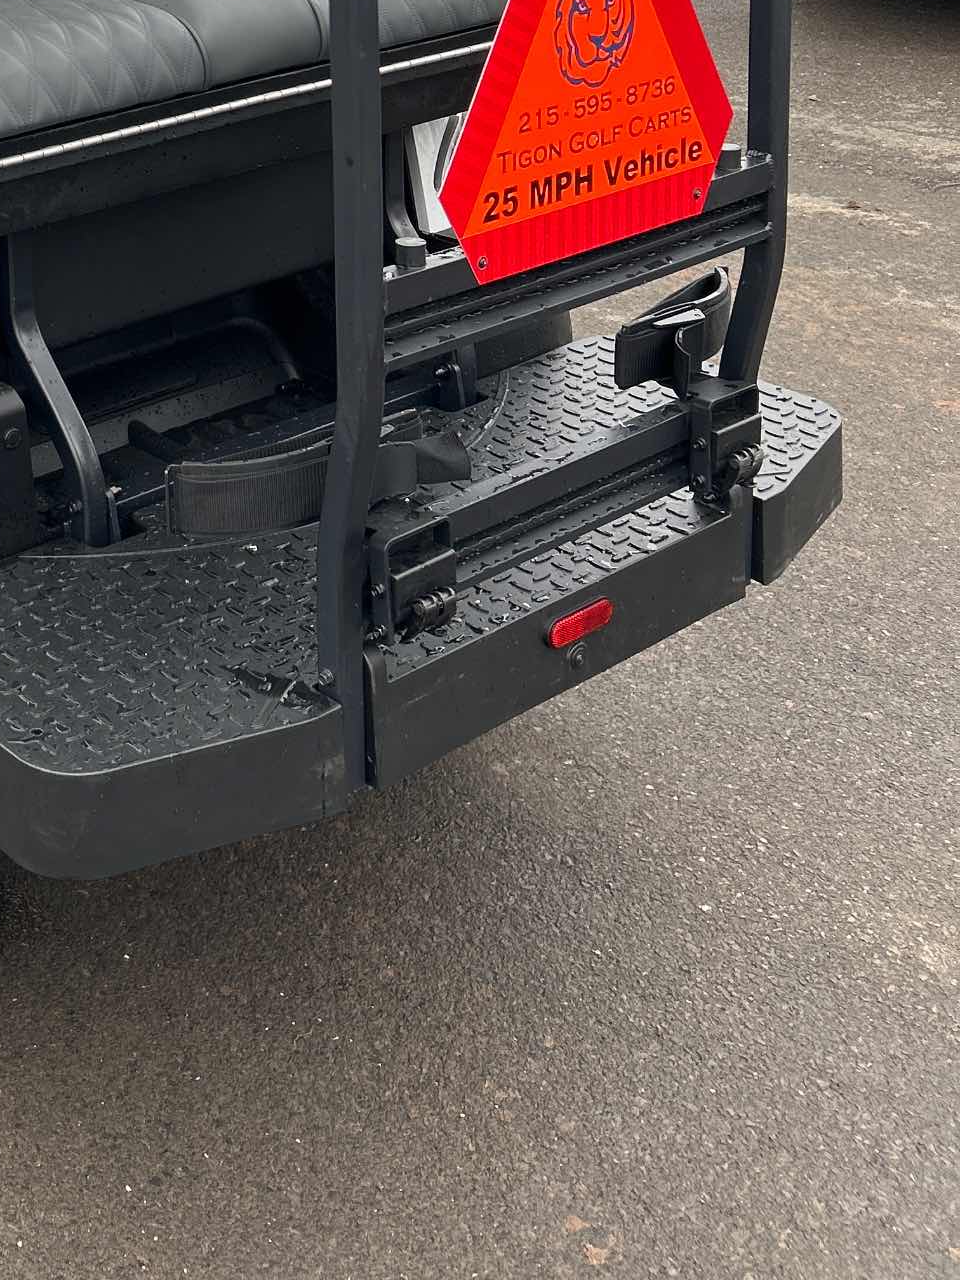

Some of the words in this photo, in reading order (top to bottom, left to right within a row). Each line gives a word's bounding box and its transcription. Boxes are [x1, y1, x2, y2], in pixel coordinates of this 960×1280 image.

[497, 140, 562, 173] TIGON
[569, 125, 623, 154] GOLF
[628, 106, 692, 138] CARTS
[482, 186, 519, 223] 25
[530, 165, 593, 209] MPH
[604, 137, 703, 186] Vehicle
